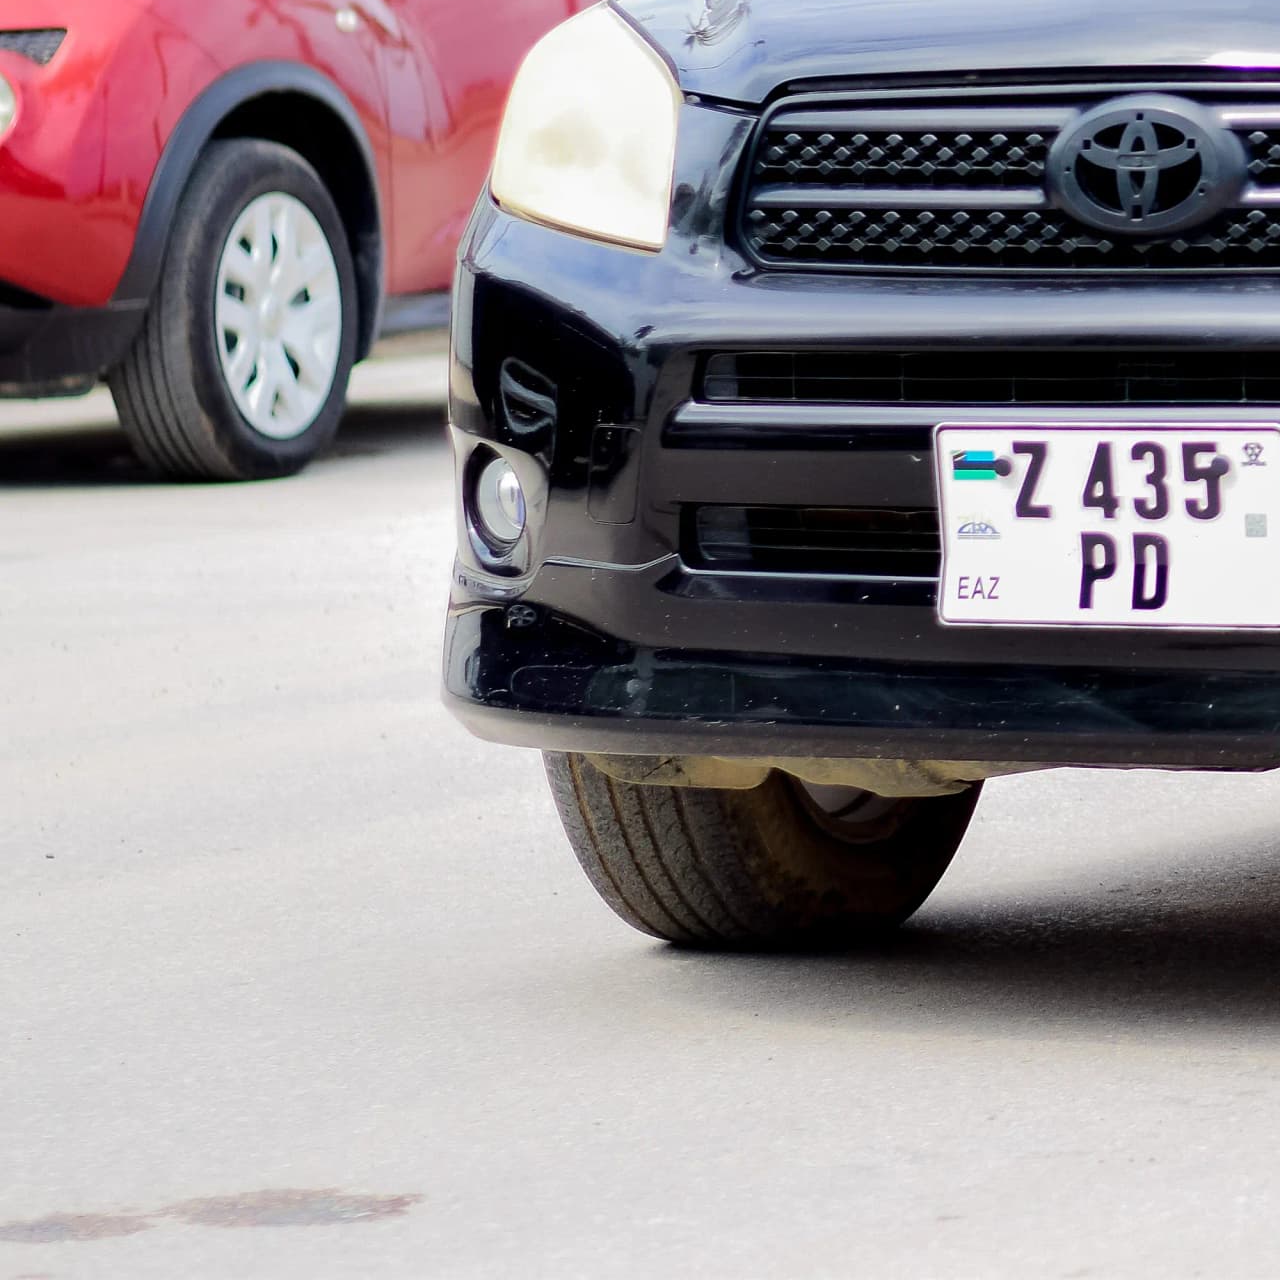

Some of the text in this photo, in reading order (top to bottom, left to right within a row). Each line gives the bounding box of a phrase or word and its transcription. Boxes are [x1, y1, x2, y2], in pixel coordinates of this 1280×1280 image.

[1012, 441, 1224, 520] Z 435
[957, 576, 1000, 600] EAZ
[1079, 531, 1170, 610] PD
